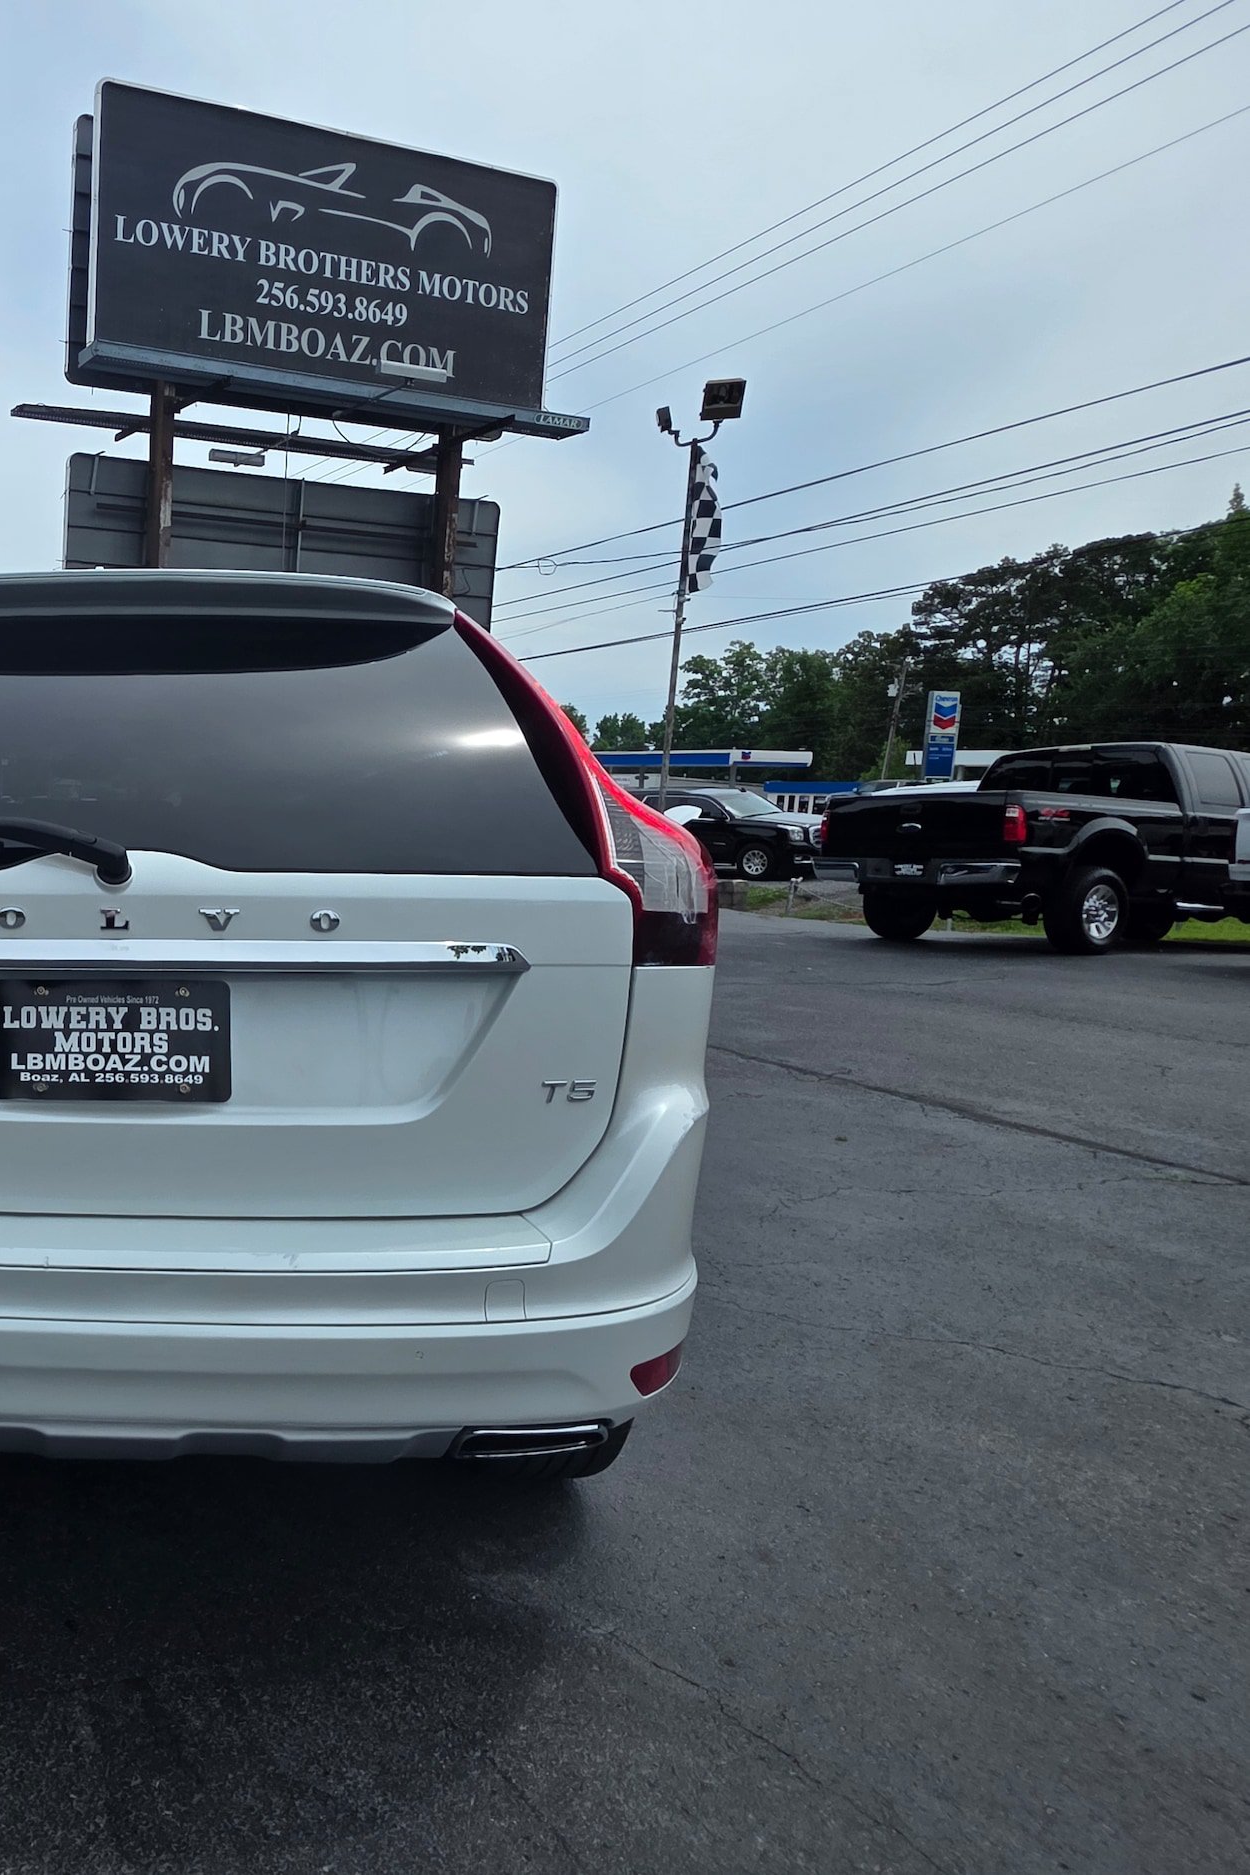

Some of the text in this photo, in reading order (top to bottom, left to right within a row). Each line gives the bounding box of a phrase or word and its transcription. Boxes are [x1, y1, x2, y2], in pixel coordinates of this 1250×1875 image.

[114, 214, 529, 315] LOWERY BROTHERS MOTORS
[255, 278, 408, 327] 256.593.8649
[197, 308, 457, 378] LBMBOAZ.COM
[540, 415, 579, 428] LAMAR
[100, 995, 126, 1004] Vehicles
[126, 995, 144, 1004] Since
[3, 1006, 220, 1032] LOWERY BROS.
[54, 1031, 169, 1053] MOTORS
[10, 1053, 210, 1073] LBMBOAZ.COM
[20, 1072, 204, 1084] Boaz, AL 256.593.8649
[541, 1079, 597, 1104] T5
